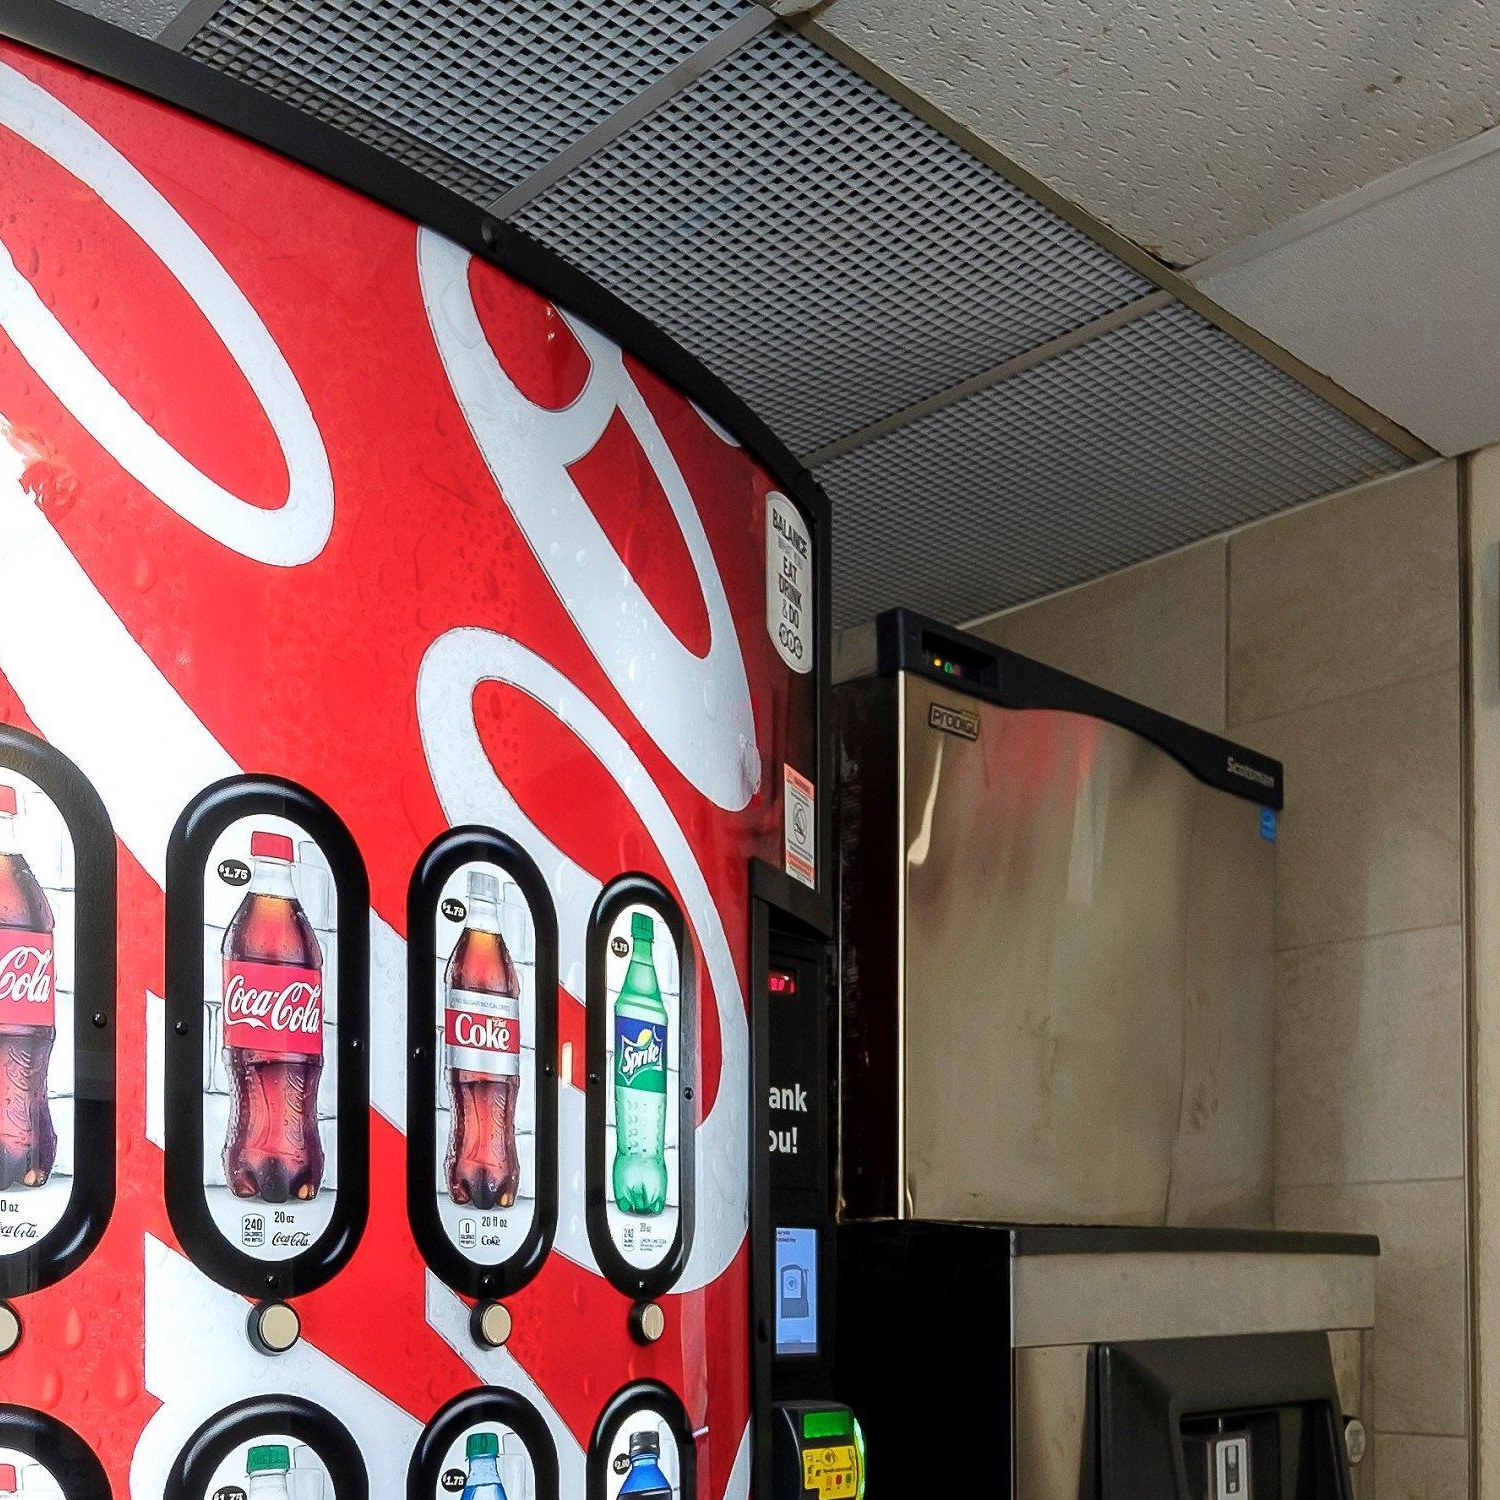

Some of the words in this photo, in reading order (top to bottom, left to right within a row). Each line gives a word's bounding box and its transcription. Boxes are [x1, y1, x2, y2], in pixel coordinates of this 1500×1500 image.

[218, 864, 248, 881] $1.75
[225, 974, 321, 1034] Coca-Cola
[455, 1013, 510, 1051] Coke
[623, 1041, 660, 1077] Sprite
[768, 1083, 808, 1113] ank
[768, 1126, 798, 1154] ou!
[8, 1203, 19, 1213] oz
[274, 1211, 285, 1224] 20
[286, 1215, 295, 1224] oz
[244, 1218, 263, 1231] 240
